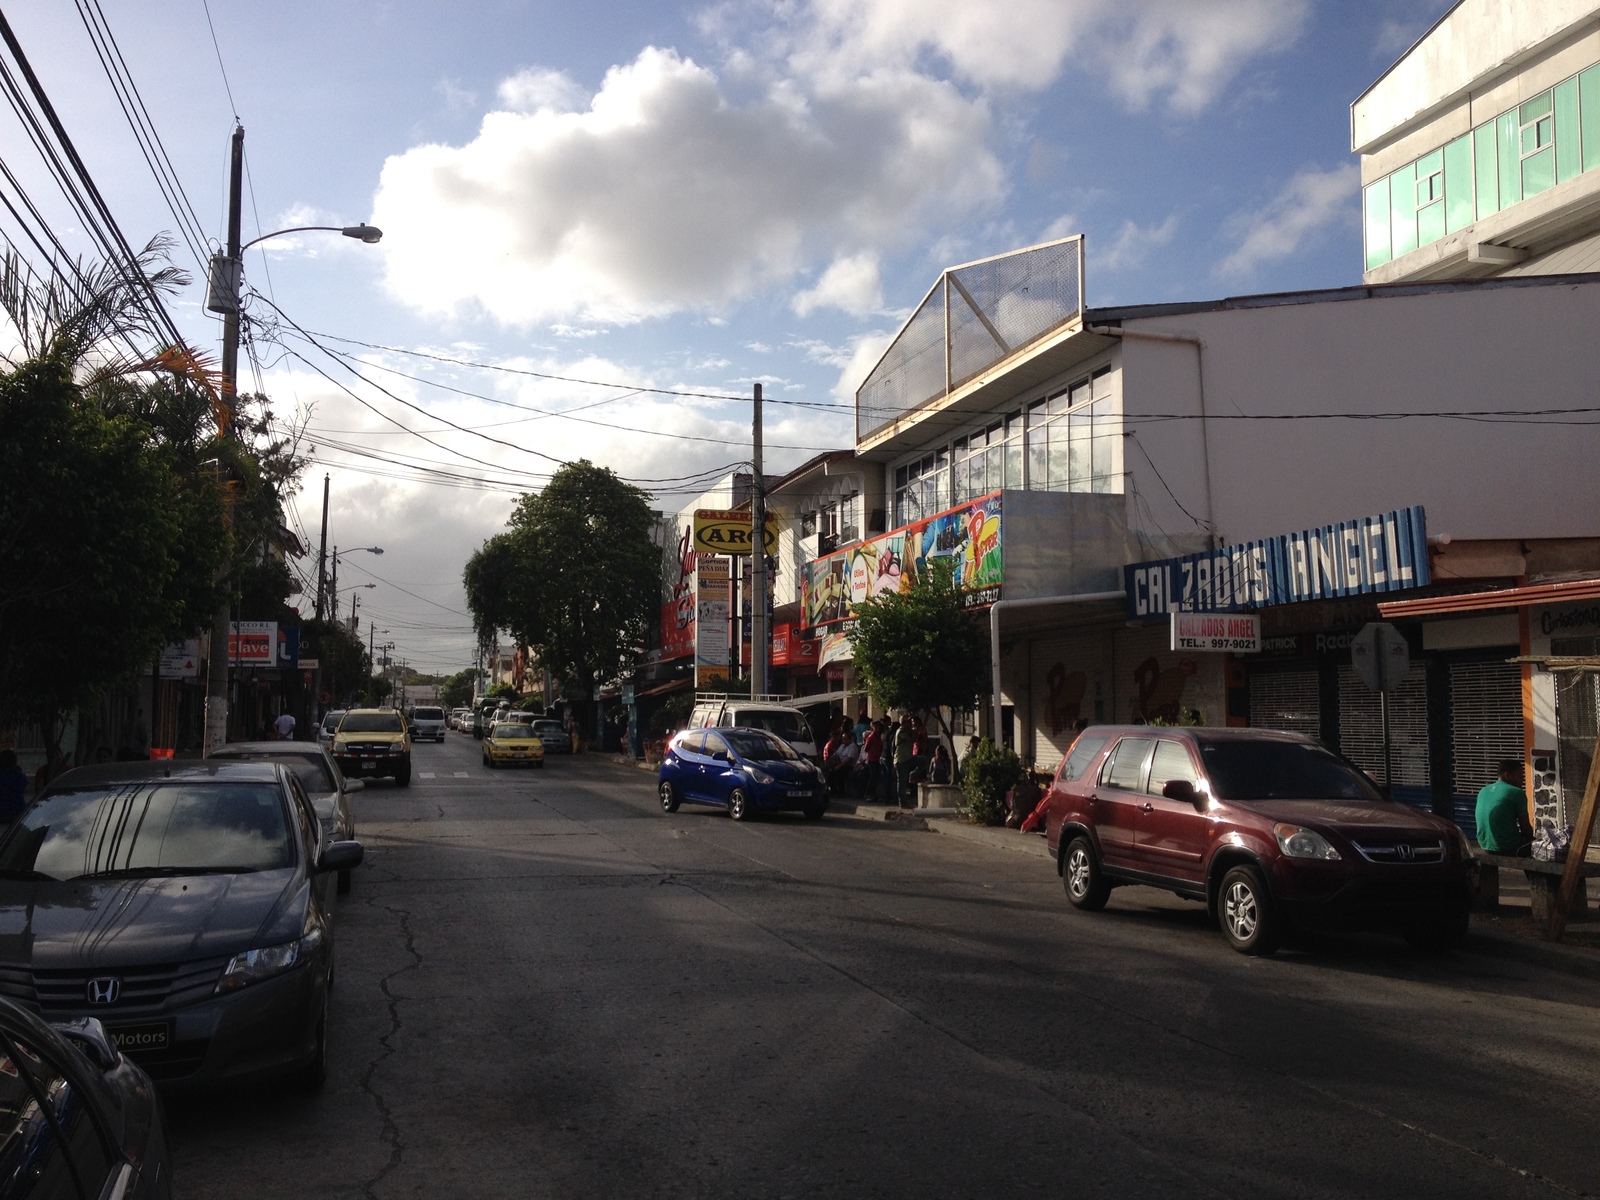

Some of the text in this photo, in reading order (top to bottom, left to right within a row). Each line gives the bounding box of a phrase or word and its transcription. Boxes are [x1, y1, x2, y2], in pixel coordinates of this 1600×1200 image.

[1134, 520, 1412, 616] CALZADOS ANGEL
[1180, 618, 1256, 638] CALZADOS ANGEL
[228, 642, 269, 653] Clave
[801, 643, 812, 656] 2
[1180, 638, 1256, 648] TEL.: 997-9021
[1261, 637, 1296, 650] PATRICK
[1316, 631, 1353, 654] Reeb
[111, 1031, 166, 1046] Motors
